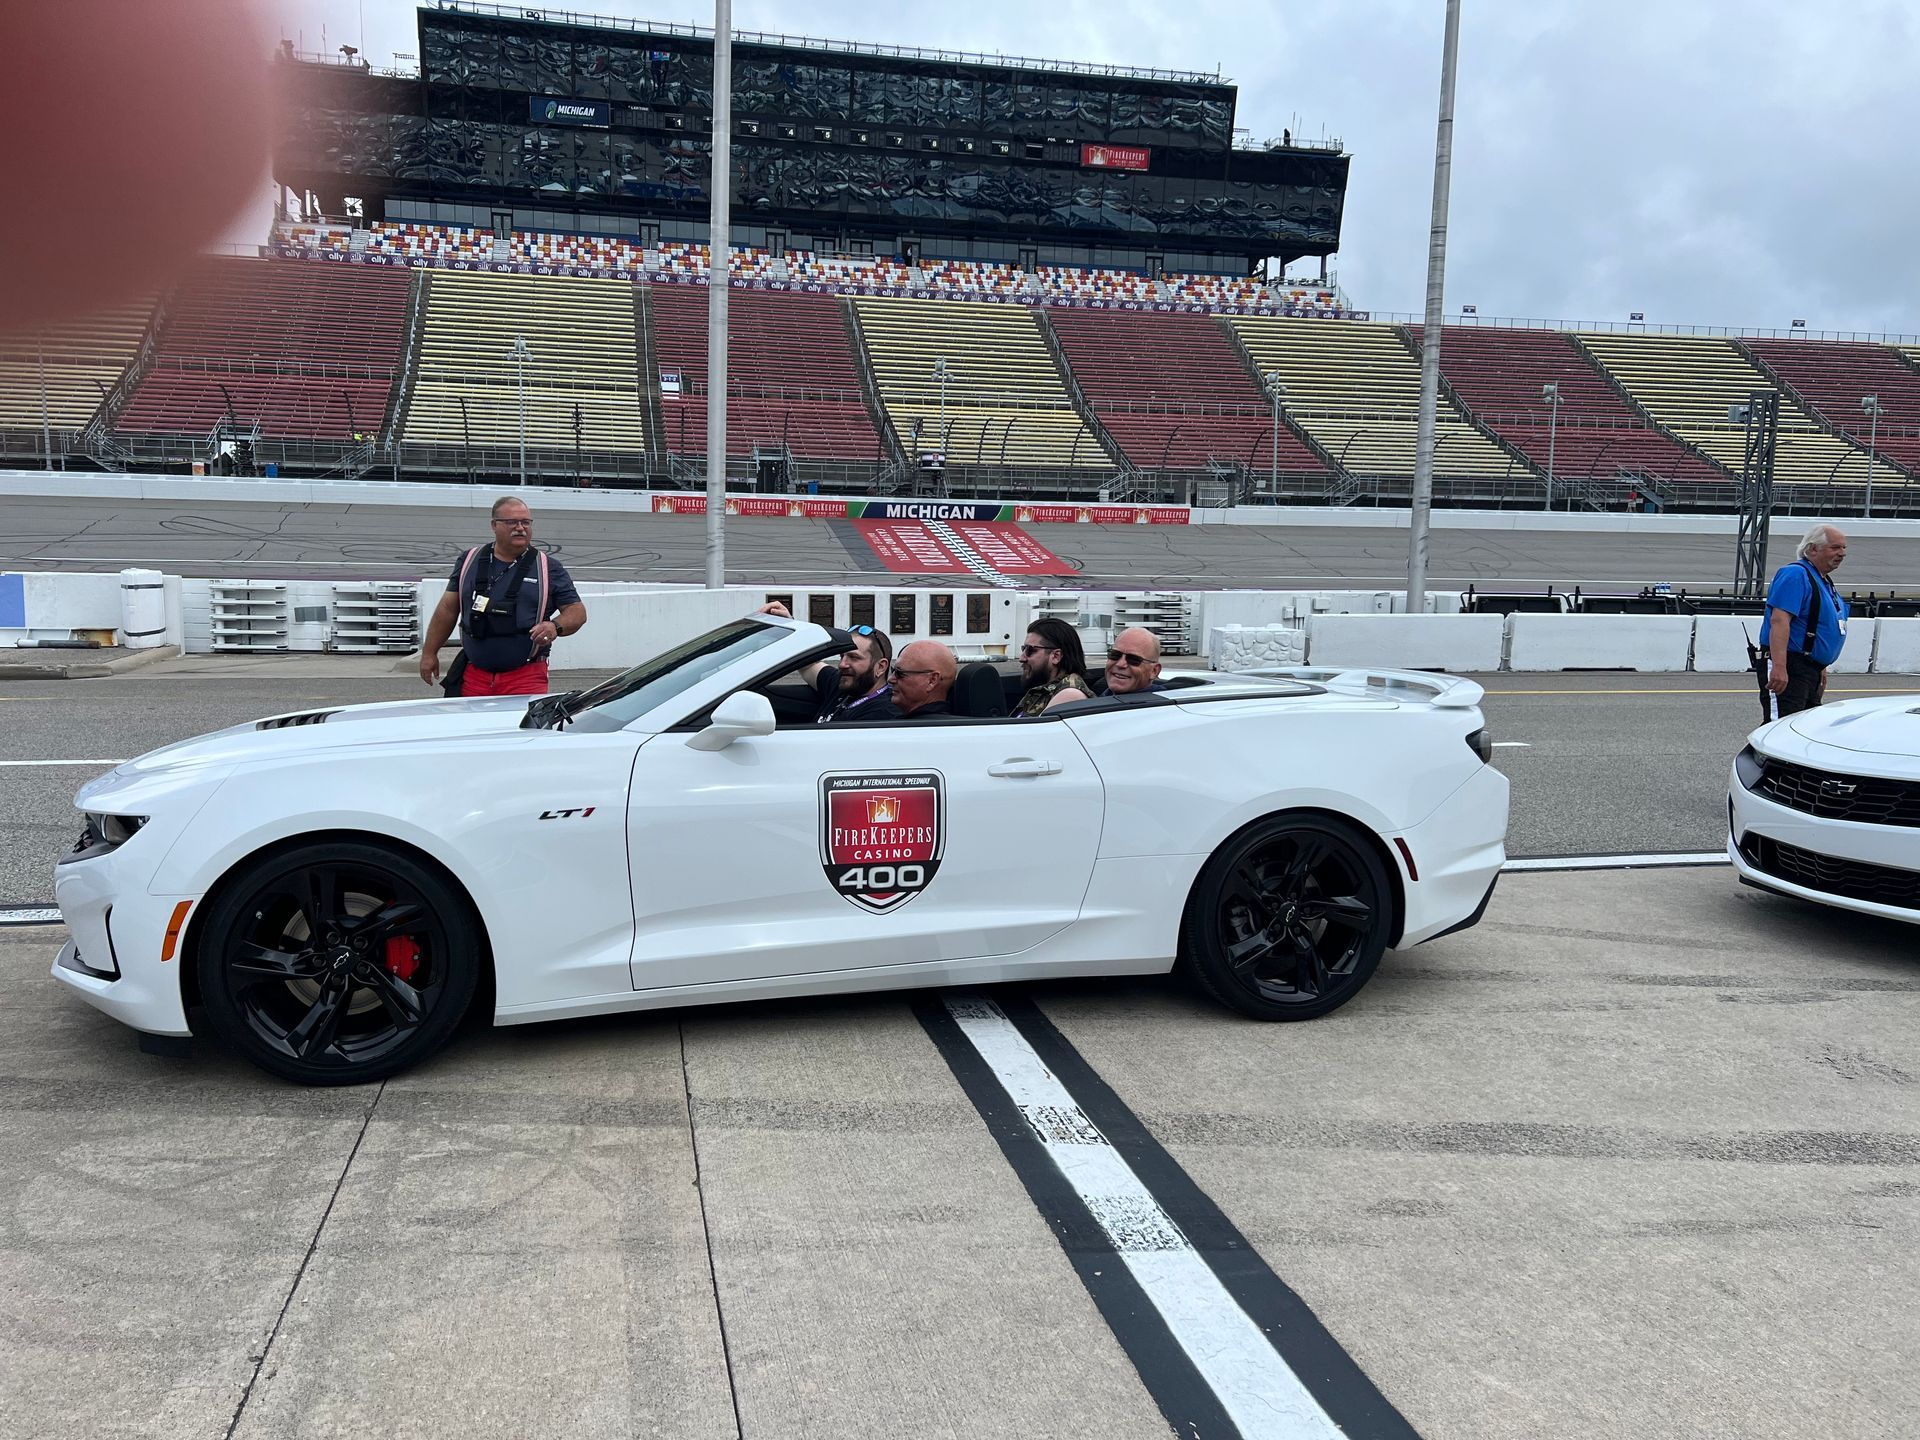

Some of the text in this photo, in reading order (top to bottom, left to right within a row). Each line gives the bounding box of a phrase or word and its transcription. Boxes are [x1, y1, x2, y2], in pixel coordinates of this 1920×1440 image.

[557, 105, 595, 116] MICHIGAN
[286, 250, 300, 259] ally
[328, 253, 344, 261] ally
[371, 256, 386, 264] ally
[414, 259, 428, 267] ally
[455, 262, 469, 270] ally
[498, 264, 512, 273] ally
[538, 267, 552, 276] ally
[578, 269, 592, 278] ally
[617, 272, 631, 281] ally
[656, 274, 670, 283] ally
[696, 277, 709, 286] ally
[734, 279, 747, 288] ally
[771, 282, 784, 290] ally
[808, 284, 821, 293] ally
[845, 286, 858, 295] ally
[882, 289, 894, 297] ally
[918, 291, 930, 299] ally
[953, 292, 965, 301] ally
[988, 295, 1000, 304] ally
[677, 499, 707, 507] FIREKEEP
[744, 501, 782, 510] FIREKEEPERS
[886, 504, 975, 519] MICHIGAN
[1036, 508, 1072, 517] FIREKEEPERS
[1095, 509, 1131, 518] FIREKEEPERS
[1153, 510, 1188, 519] FIREKEEPERS
[538, 807, 596, 820] LT1
[834, 826, 932, 847] FIREKEEPERS
[854, 849, 912, 860] CASINO
[839, 865, 925, 889] 400
